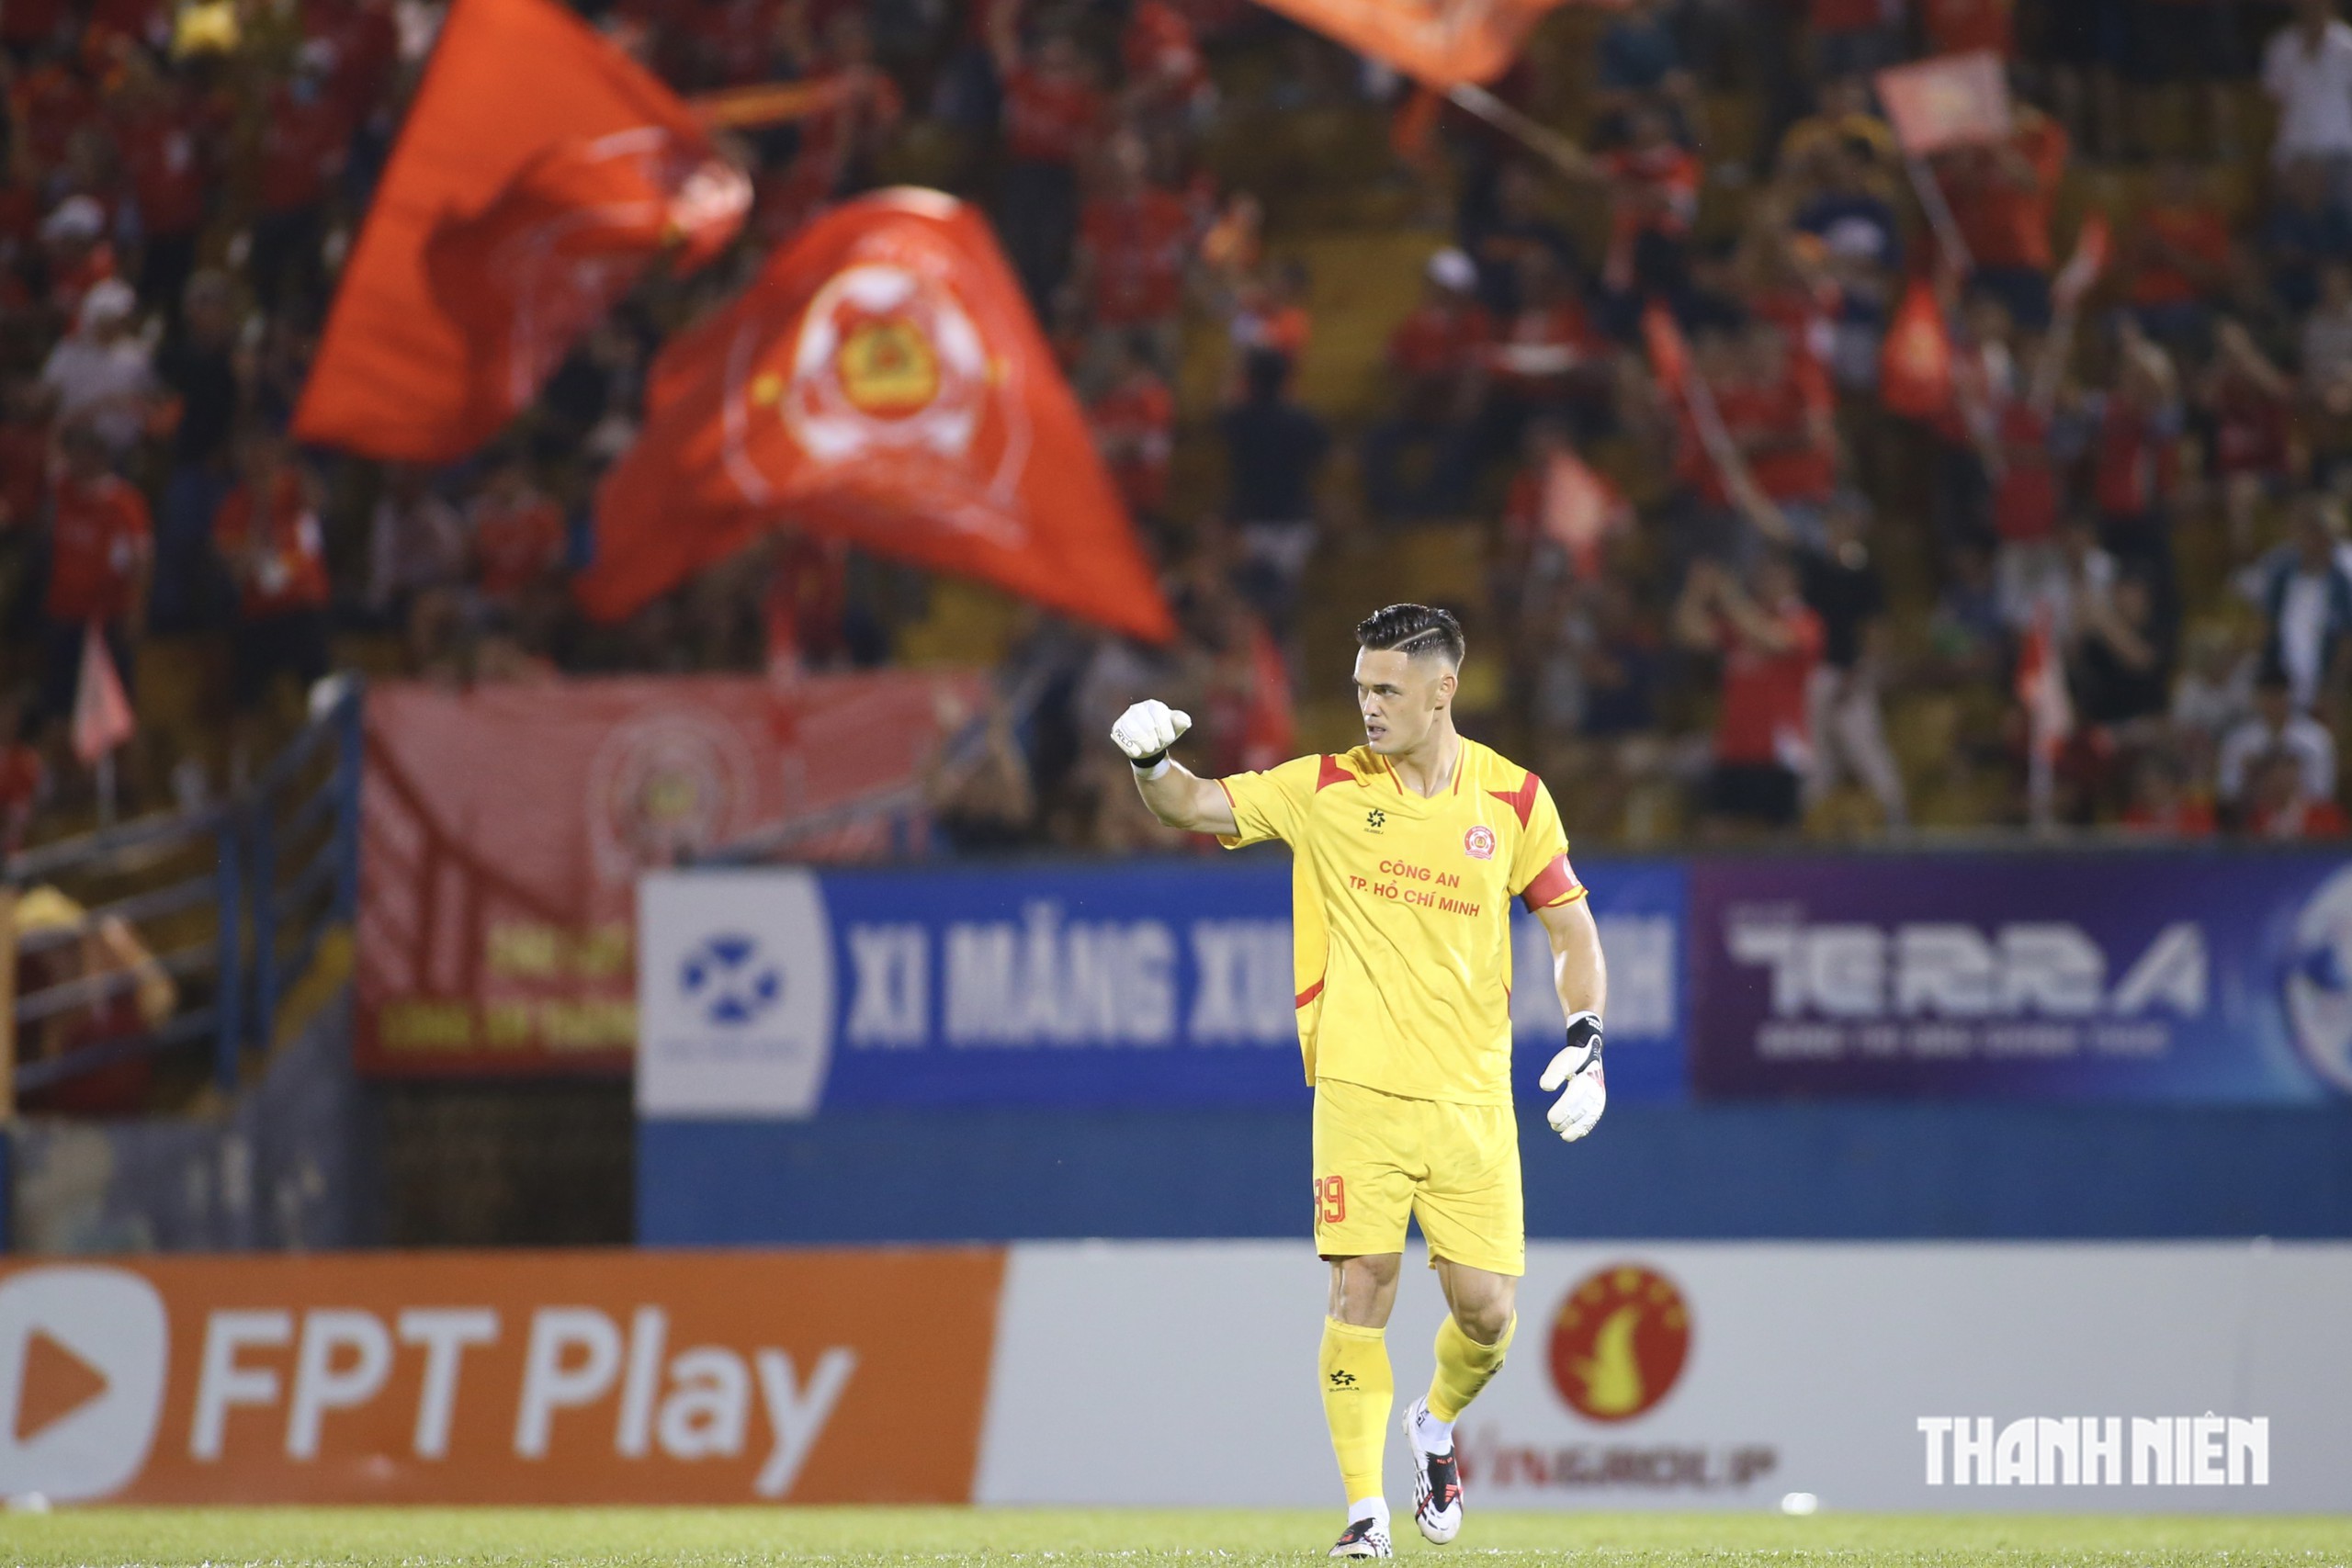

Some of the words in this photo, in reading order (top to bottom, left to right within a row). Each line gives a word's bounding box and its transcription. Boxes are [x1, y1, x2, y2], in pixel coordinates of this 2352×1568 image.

[1349, 874, 1368, 892] TP.
[1374, 879, 1398, 899] HỒ
[1404, 890, 1437, 908] CHÍ
[1438, 897, 1480, 918] MINH
[1379, 859, 1431, 882] CÔNG
[1435, 872, 1460, 888] AN
[849, 920, 926, 1049] XI
[1192, 917, 1297, 1049] XU
[1727, 919, 2208, 1020] TERRA
[189, 1306, 502, 1462] FPT
[512, 1304, 858, 1499] Play
